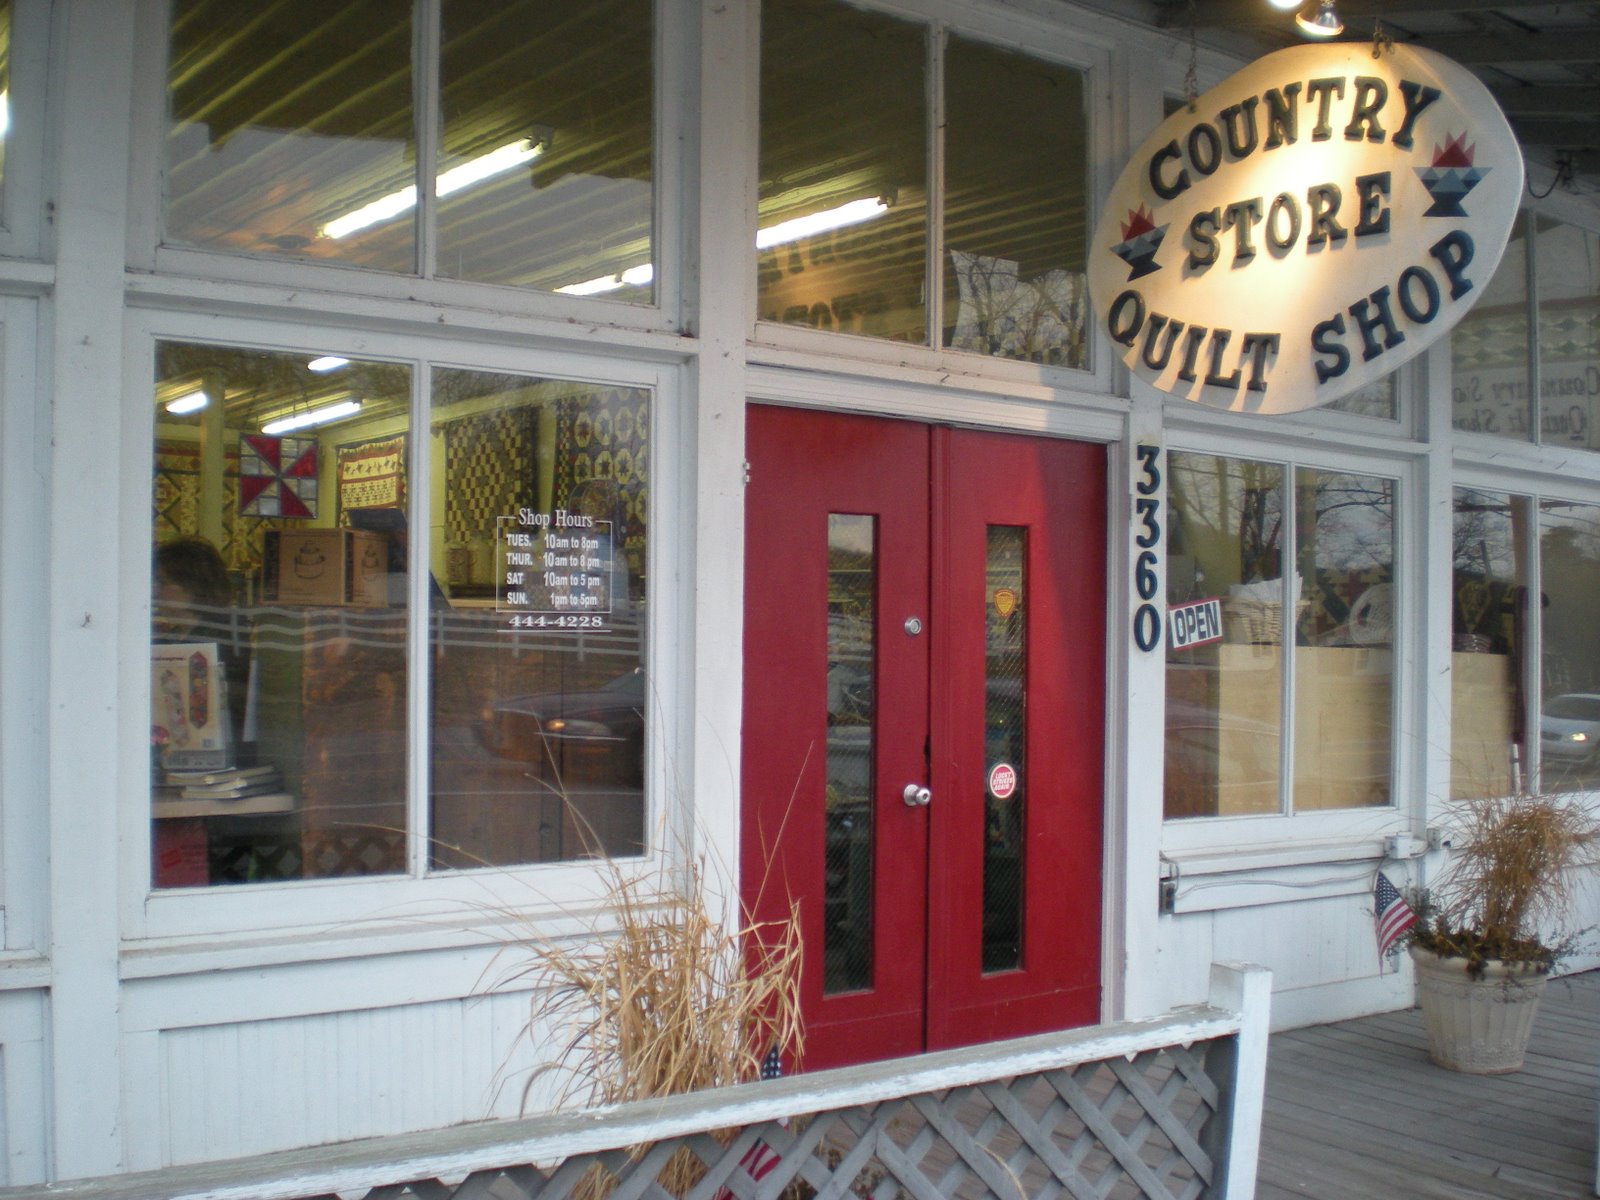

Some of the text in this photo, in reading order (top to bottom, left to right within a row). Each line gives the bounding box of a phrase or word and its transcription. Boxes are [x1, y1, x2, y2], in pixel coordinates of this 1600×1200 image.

[1149, 76, 1442, 200] COUNTRY
[1189, 171, 1392, 270] STORE
[1108, 229, 1475, 392] QUILT SHOP
[518, 507, 594, 529] Shop Hours
[506, 534, 532, 547] TUES.
[571, 537, 579, 548] to
[581, 536, 599, 551] 8pm
[1134, 445, 1161, 652] 3360
[506, 552, 533, 566] THUR.
[570, 556, 578, 567] to
[506, 572, 524, 585] SAT
[570, 575, 579, 586] to
[507, 592, 598, 609] SUN. 1pm to 5pm
[508, 615, 603, 628] 444-4228
[1174, 602, 1219, 645] OPEN
